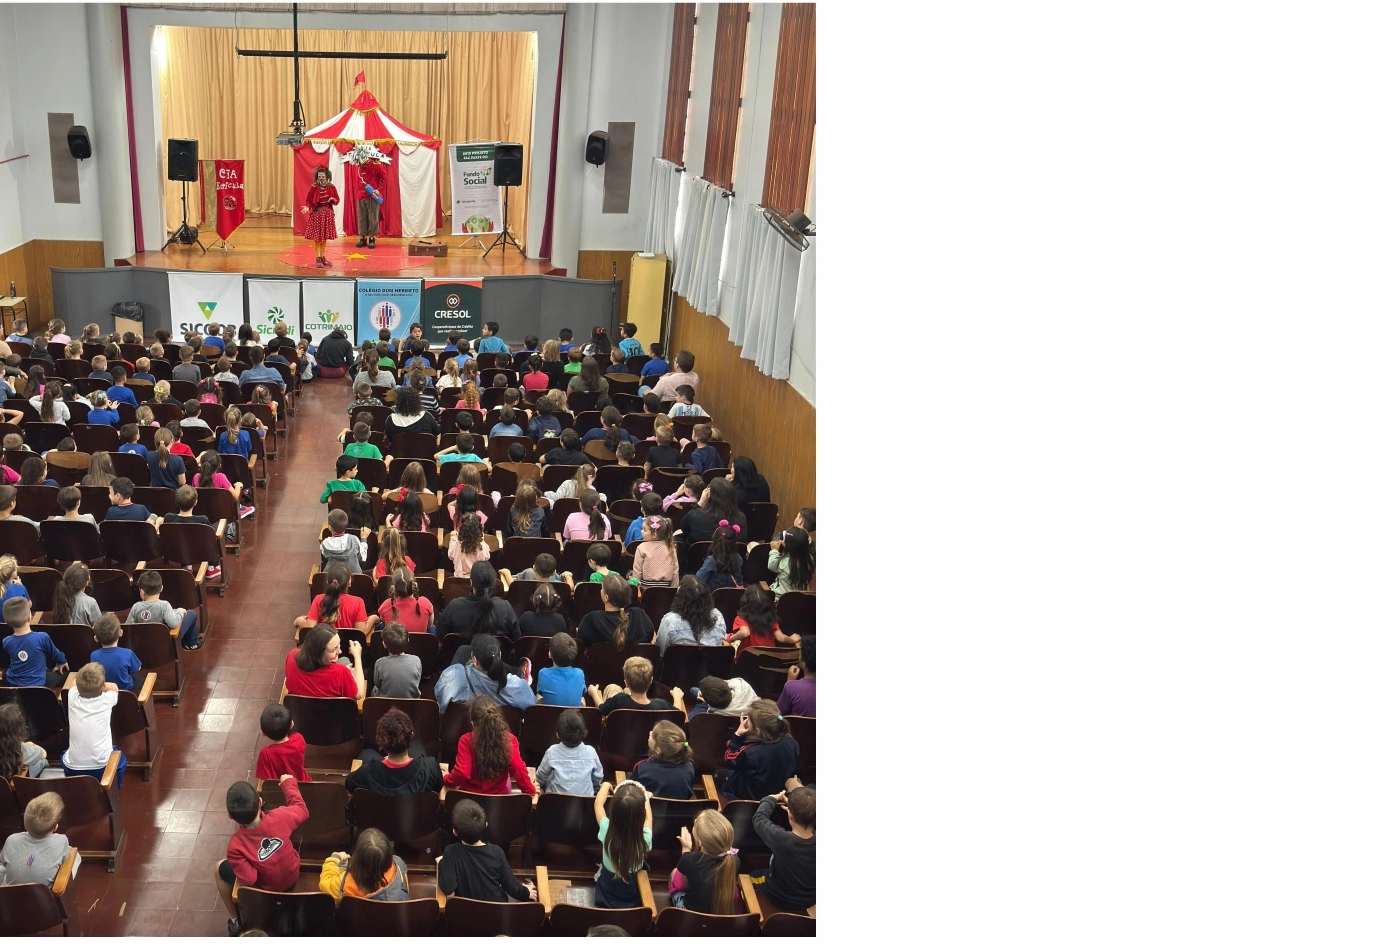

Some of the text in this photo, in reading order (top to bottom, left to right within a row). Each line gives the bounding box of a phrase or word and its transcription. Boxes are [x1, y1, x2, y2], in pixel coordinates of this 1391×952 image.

[463, 176, 487, 186] Social
[434, 310, 471, 319] CRESOL
[305, 322, 353, 331] COTRIMAIO
